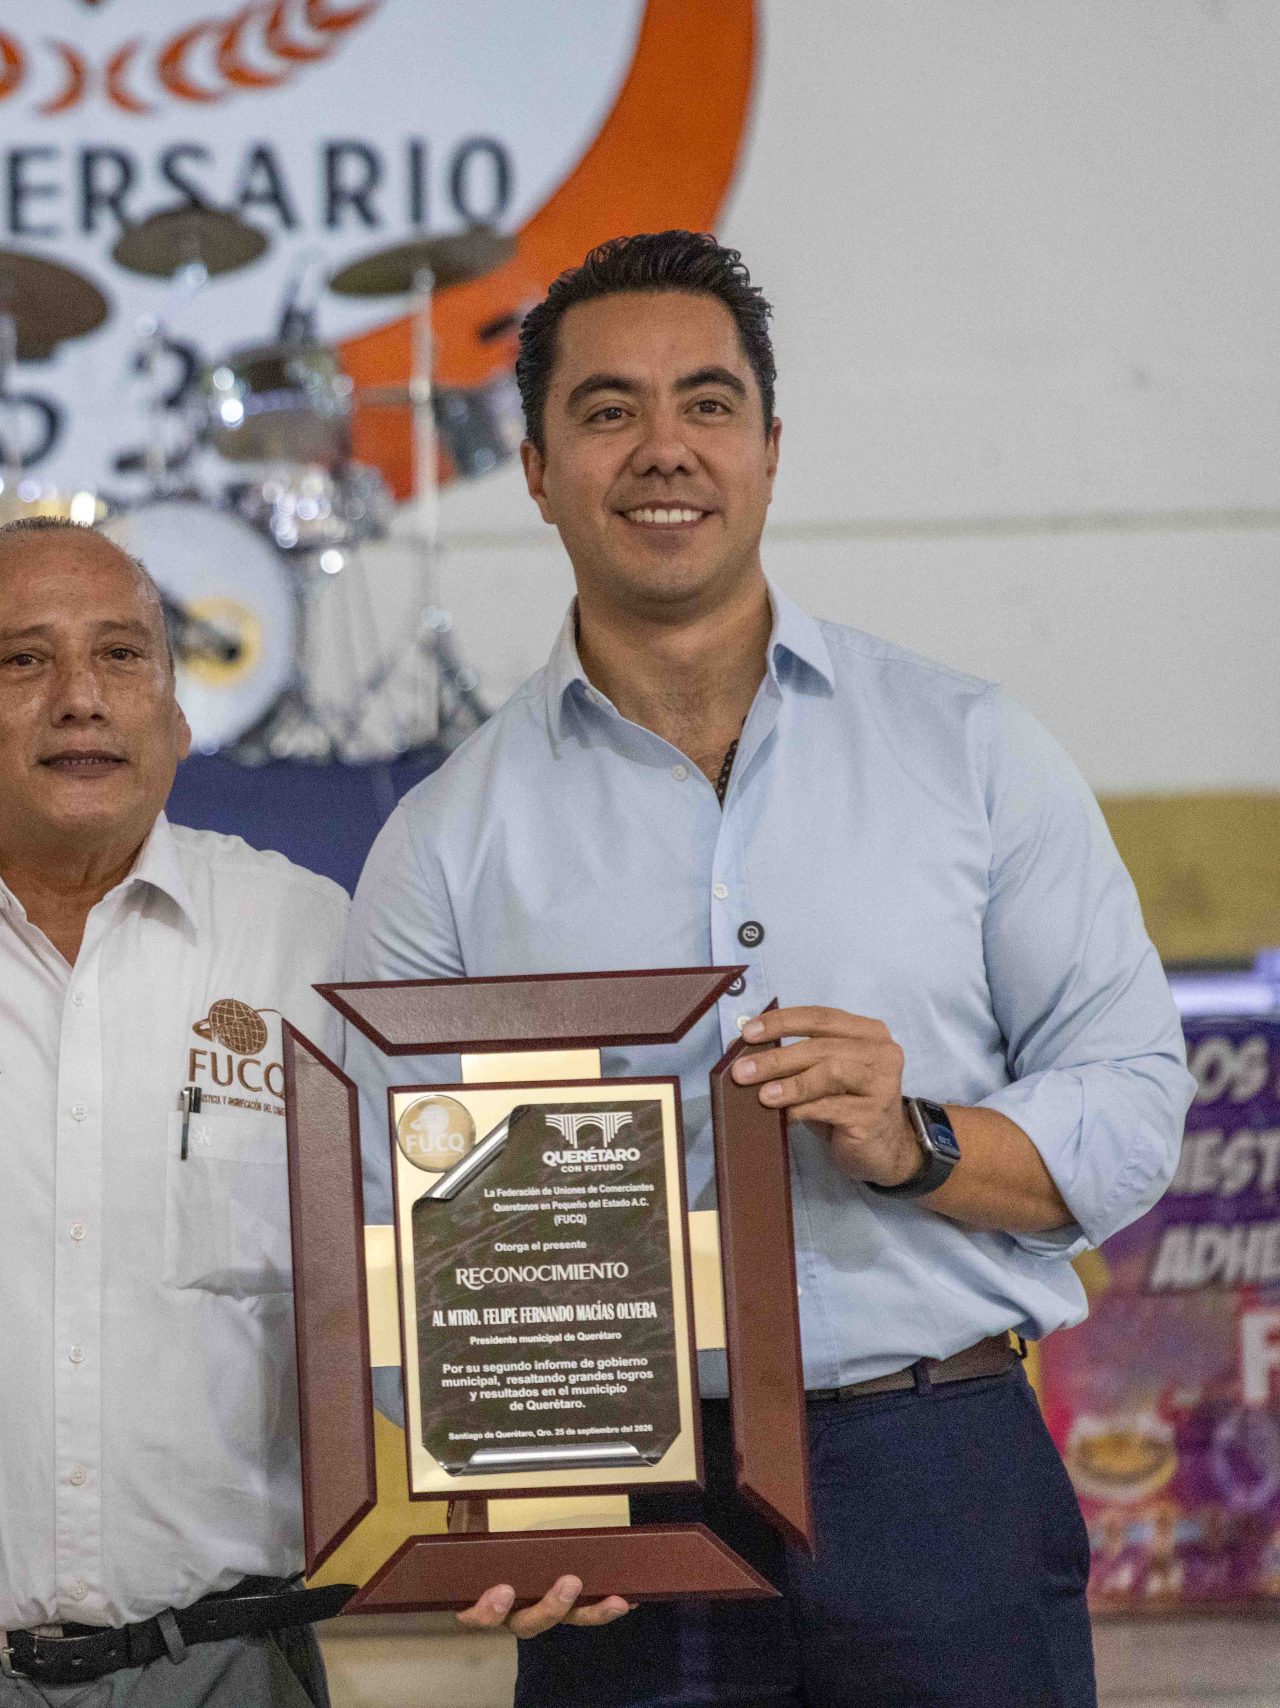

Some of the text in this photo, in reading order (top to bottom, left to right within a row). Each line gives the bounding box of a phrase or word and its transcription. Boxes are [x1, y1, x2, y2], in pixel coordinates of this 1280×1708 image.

[406, 1133, 465, 1153] FUCQ
[542, 1148, 641, 1165] QUERÉTARO
[584, 1163, 624, 1171] FUTURO
[483, 1183, 654, 1197] La Federación de Uniones de Comerciantes
[551, 1200, 587, 1211] Pequeño
[588, 1199, 601, 1208] del
[602, 1198, 630, 1207] Estado
[631, 1197, 649, 1206] A.C.
[554, 1213, 587, 1226] (FUCQ)
[494, 1240, 587, 1253] Otorga el presente
[455, 1262, 628, 1290] RECONOCIMIENTO
[432, 1300, 657, 1326] AL MTRO. FELIPE FERNANDO MACÍAS OLVERA
[469, 1331, 622, 1345] Presidente municipal de Querétaro
[442, 1356, 648, 1374] Por su segundo informe de gobierno
[441, 1370, 653, 1388] municipal, resaltando grandes logros
[469, 1383, 627, 1401] y resultados en el municipio
[509, 1399, 586, 1411] de Querétaro.
